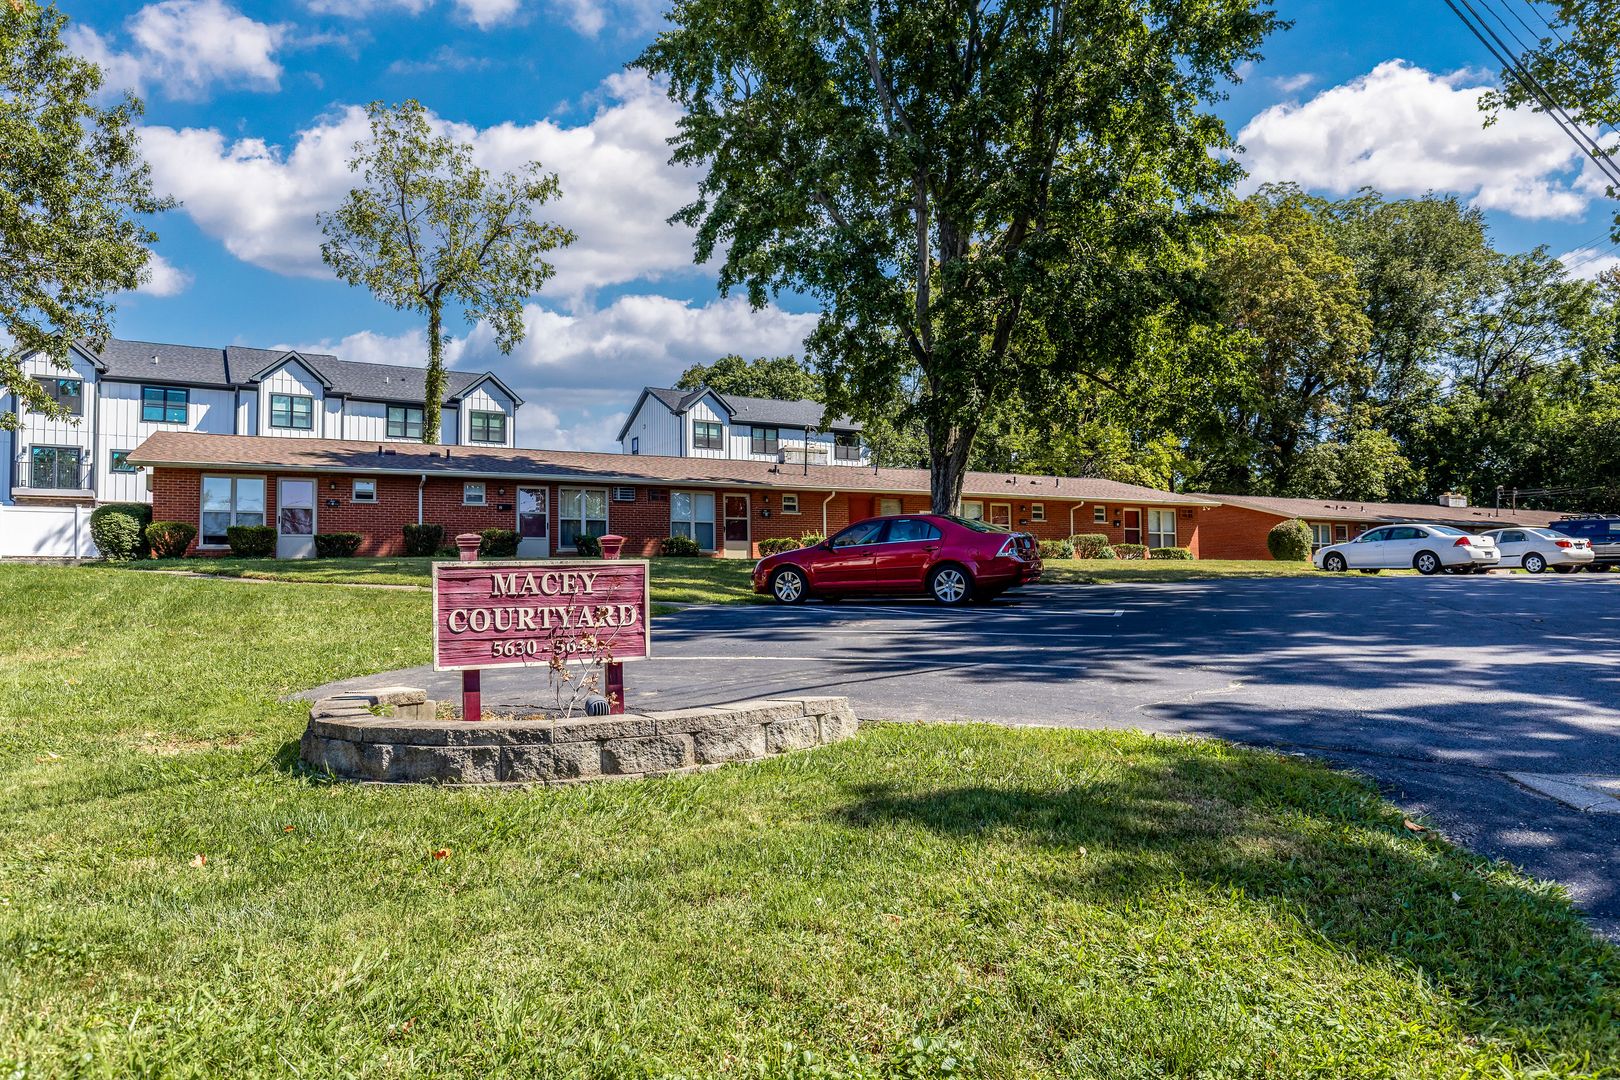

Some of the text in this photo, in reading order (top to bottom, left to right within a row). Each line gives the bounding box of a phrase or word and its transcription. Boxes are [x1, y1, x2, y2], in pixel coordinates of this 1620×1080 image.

[491, 572, 599, 597] MACEY
[448, 605, 637, 633] COURTYARD
[492, 640, 537, 656] 5630
